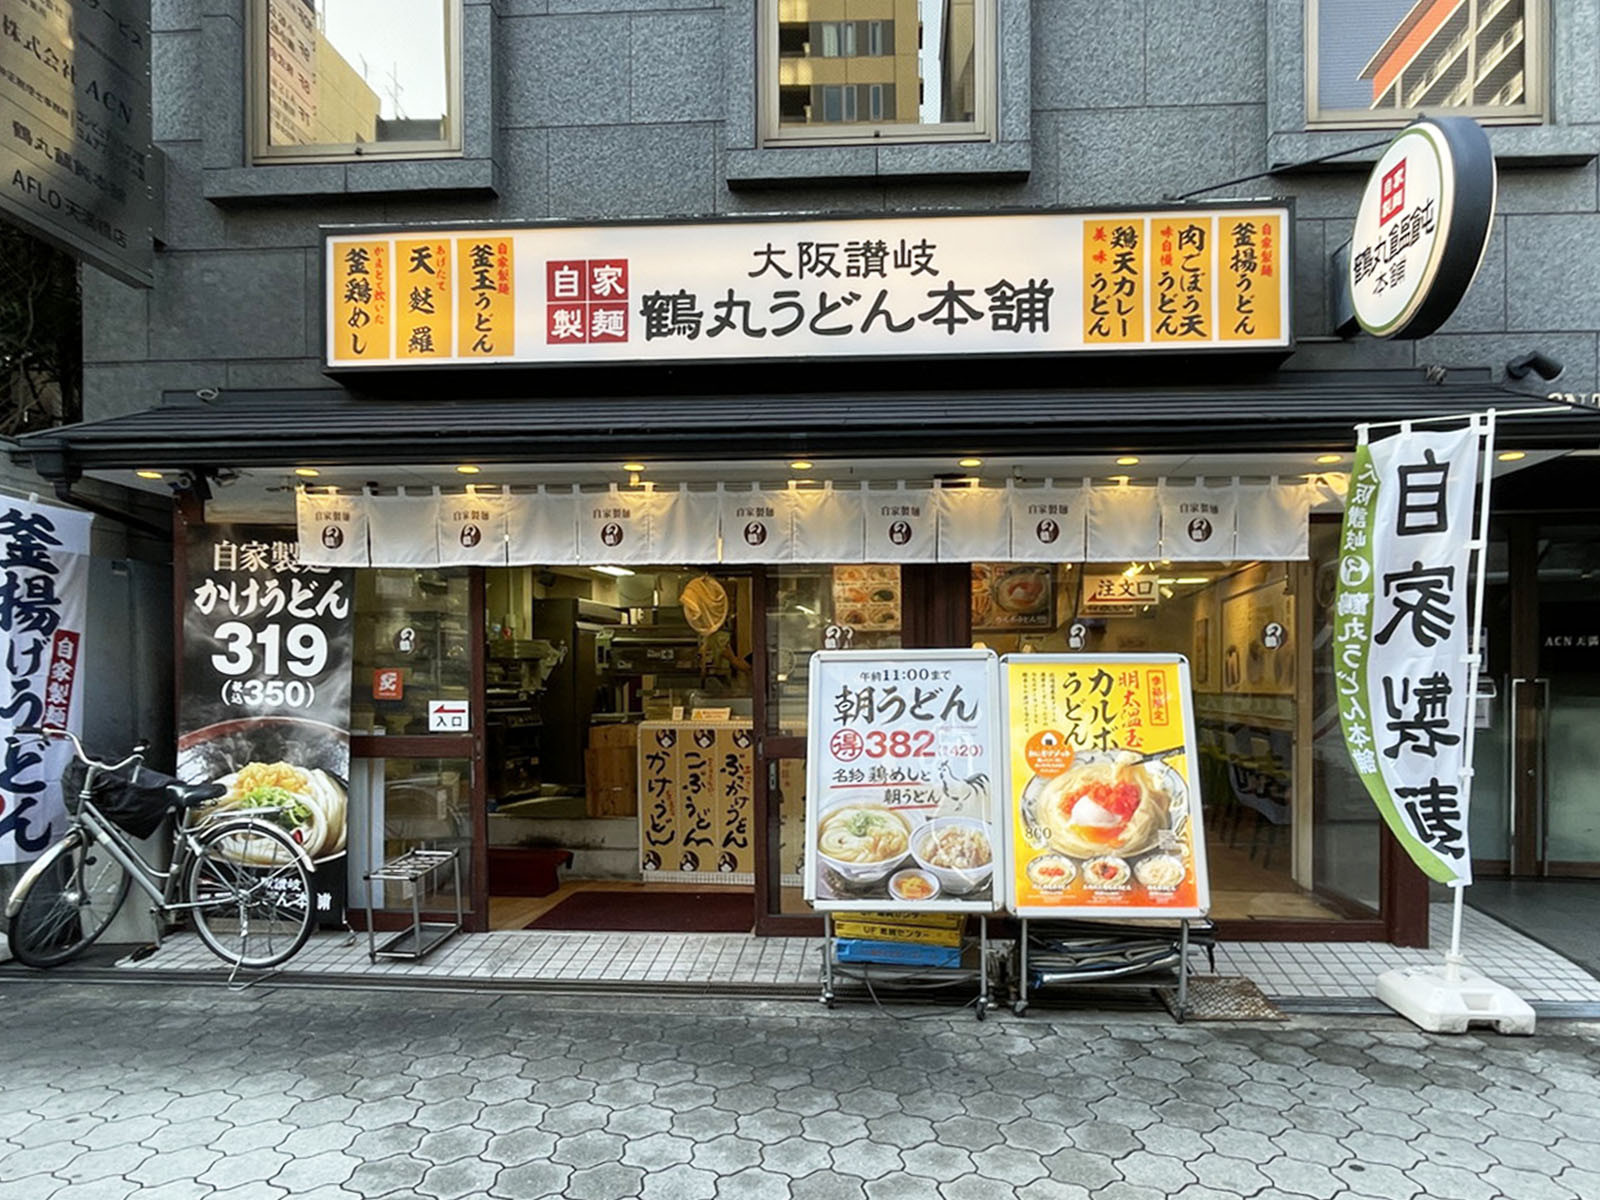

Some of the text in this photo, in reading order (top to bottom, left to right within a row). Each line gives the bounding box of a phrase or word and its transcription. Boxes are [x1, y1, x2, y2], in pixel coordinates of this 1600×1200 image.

[3, 14, 76, 85] 株式会社
[85, 80, 134, 124] ACN
[552, 263, 627, 298] 自家
[747, 238, 941, 280] 大阪讃岐
[1110, 225, 1140, 337] 鶏天カレー
[1230, 222, 1259, 335] 釜揚うどん
[344, 247, 373, 355] 釜鶏めし
[469, 243, 498, 354] 釜玉うどん
[550, 307, 626, 339] 製麺
[639, 278, 1055, 341] 鶴丸うどん本舗
[1088, 272, 1111, 337] うどん
[1155, 271, 1179, 336] うどん
[213, 540, 333, 574] 自家製
[193, 577, 349, 619] かけうどん
[1098, 579, 1153, 597] 注文口
[210, 621, 329, 677] 319
[0, 507, 62, 853] 釜揚げうどん
[833, 685, 980, 726] 朝うどん
[436, 715, 462, 727] 入口
[1062, 672, 1088, 746] うどん
[865, 730, 936, 759] 382
[884, 789, 941, 804] 朝うどん
